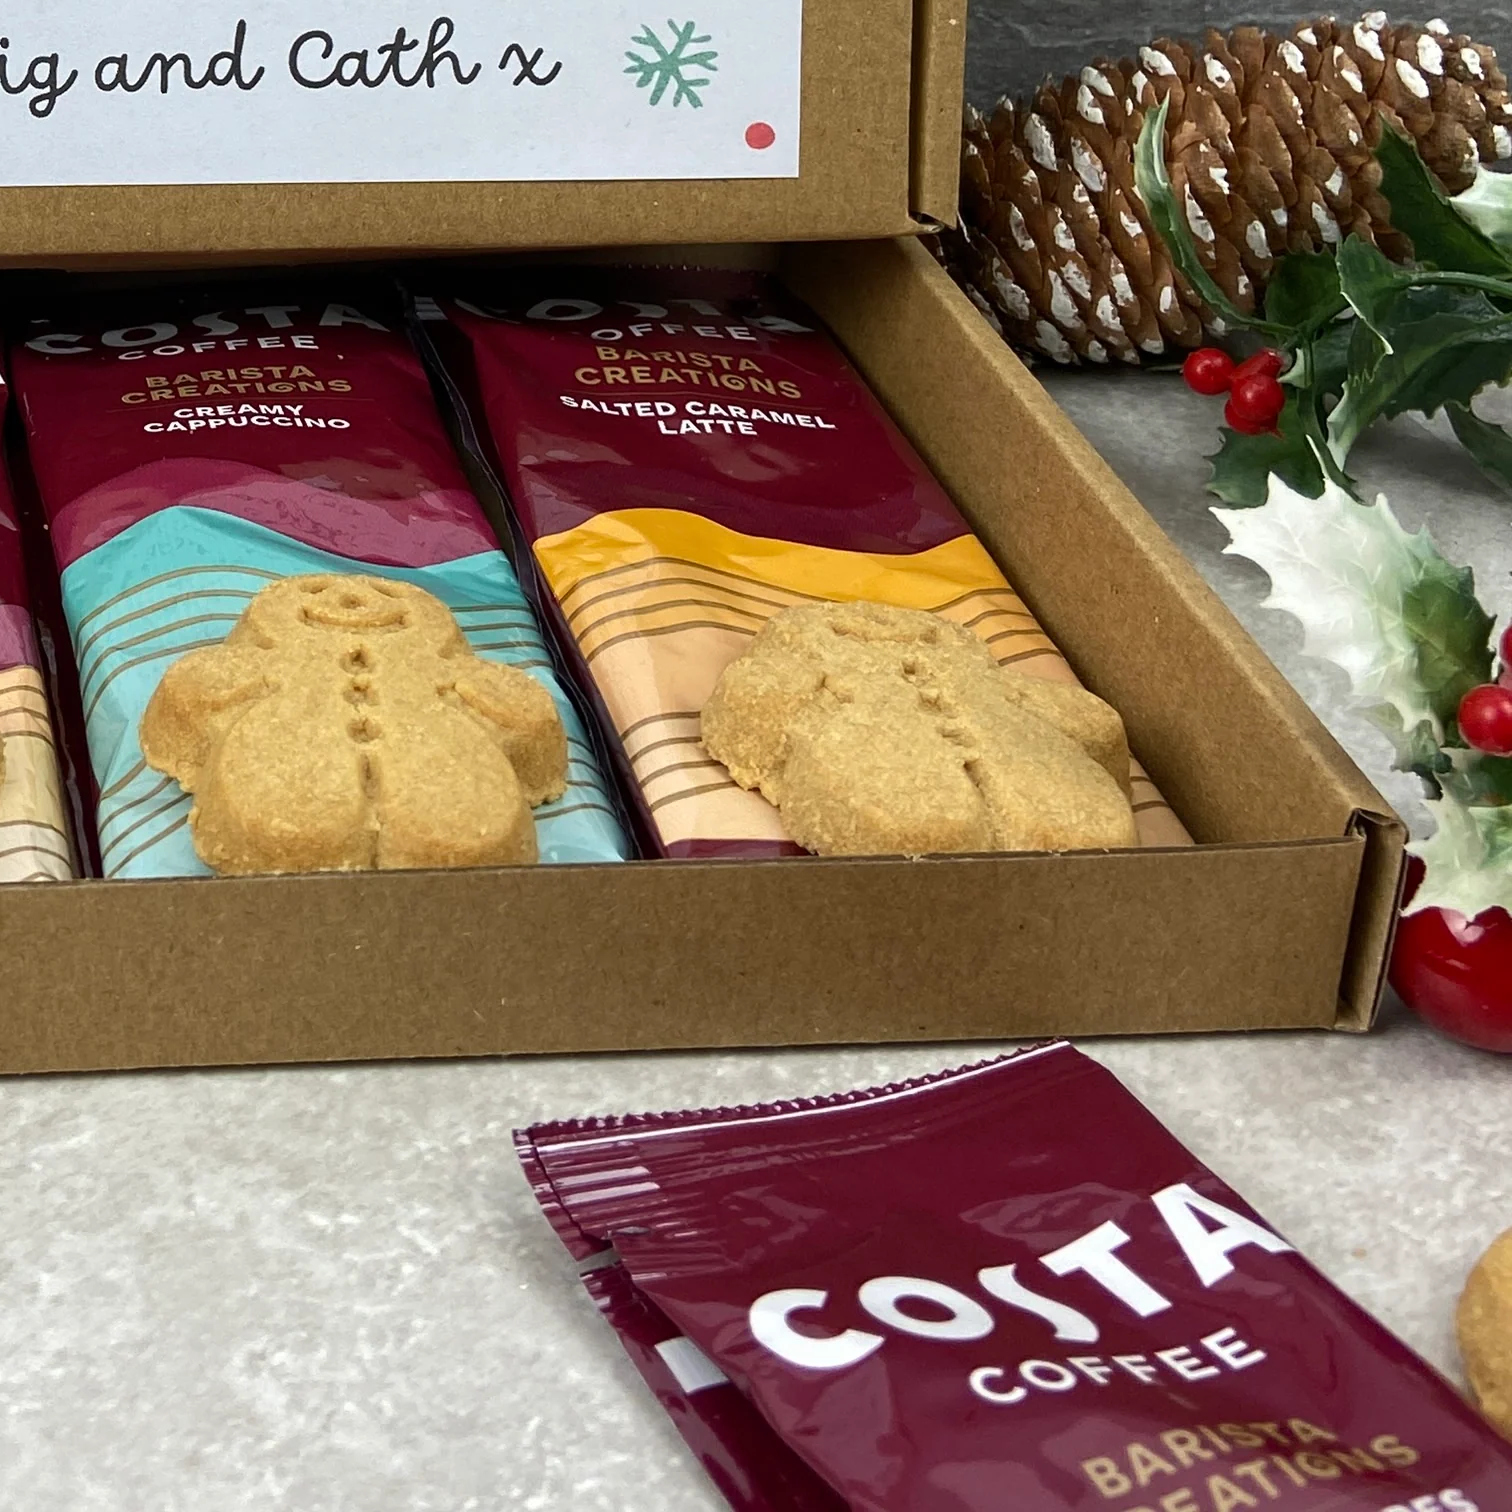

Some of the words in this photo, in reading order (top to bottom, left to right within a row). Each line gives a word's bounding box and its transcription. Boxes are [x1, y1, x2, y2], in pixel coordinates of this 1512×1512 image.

[93, 18, 266, 94] and
[287, 15, 483, 90] Cath
[497, 43, 564, 88] x
[24, 303, 391, 355] COSTA
[588, 322, 758, 342] OFFEE
[117, 334, 320, 361] COFFEE
[595, 345, 764, 374] BARISTA
[120, 378, 353, 405] CREATIONS
[144, 364, 317, 389] BARISTA
[573, 366, 802, 399] CREATIONS
[143, 416, 351, 434] CAPPUCCINO
[172, 403, 304, 419] CREAMY
[558, 394, 677, 418] SALTED
[684, 400, 839, 431] CARAMEL
[656, 418, 759, 437] LATTE
[747, 1182, 1297, 1371] COSTA
[968, 1326, 1267, 1406] COFFEE
[1080, 1417, 1338, 1499] BARISTA
[1120, 1434, 1421, 1512] EATIONS
